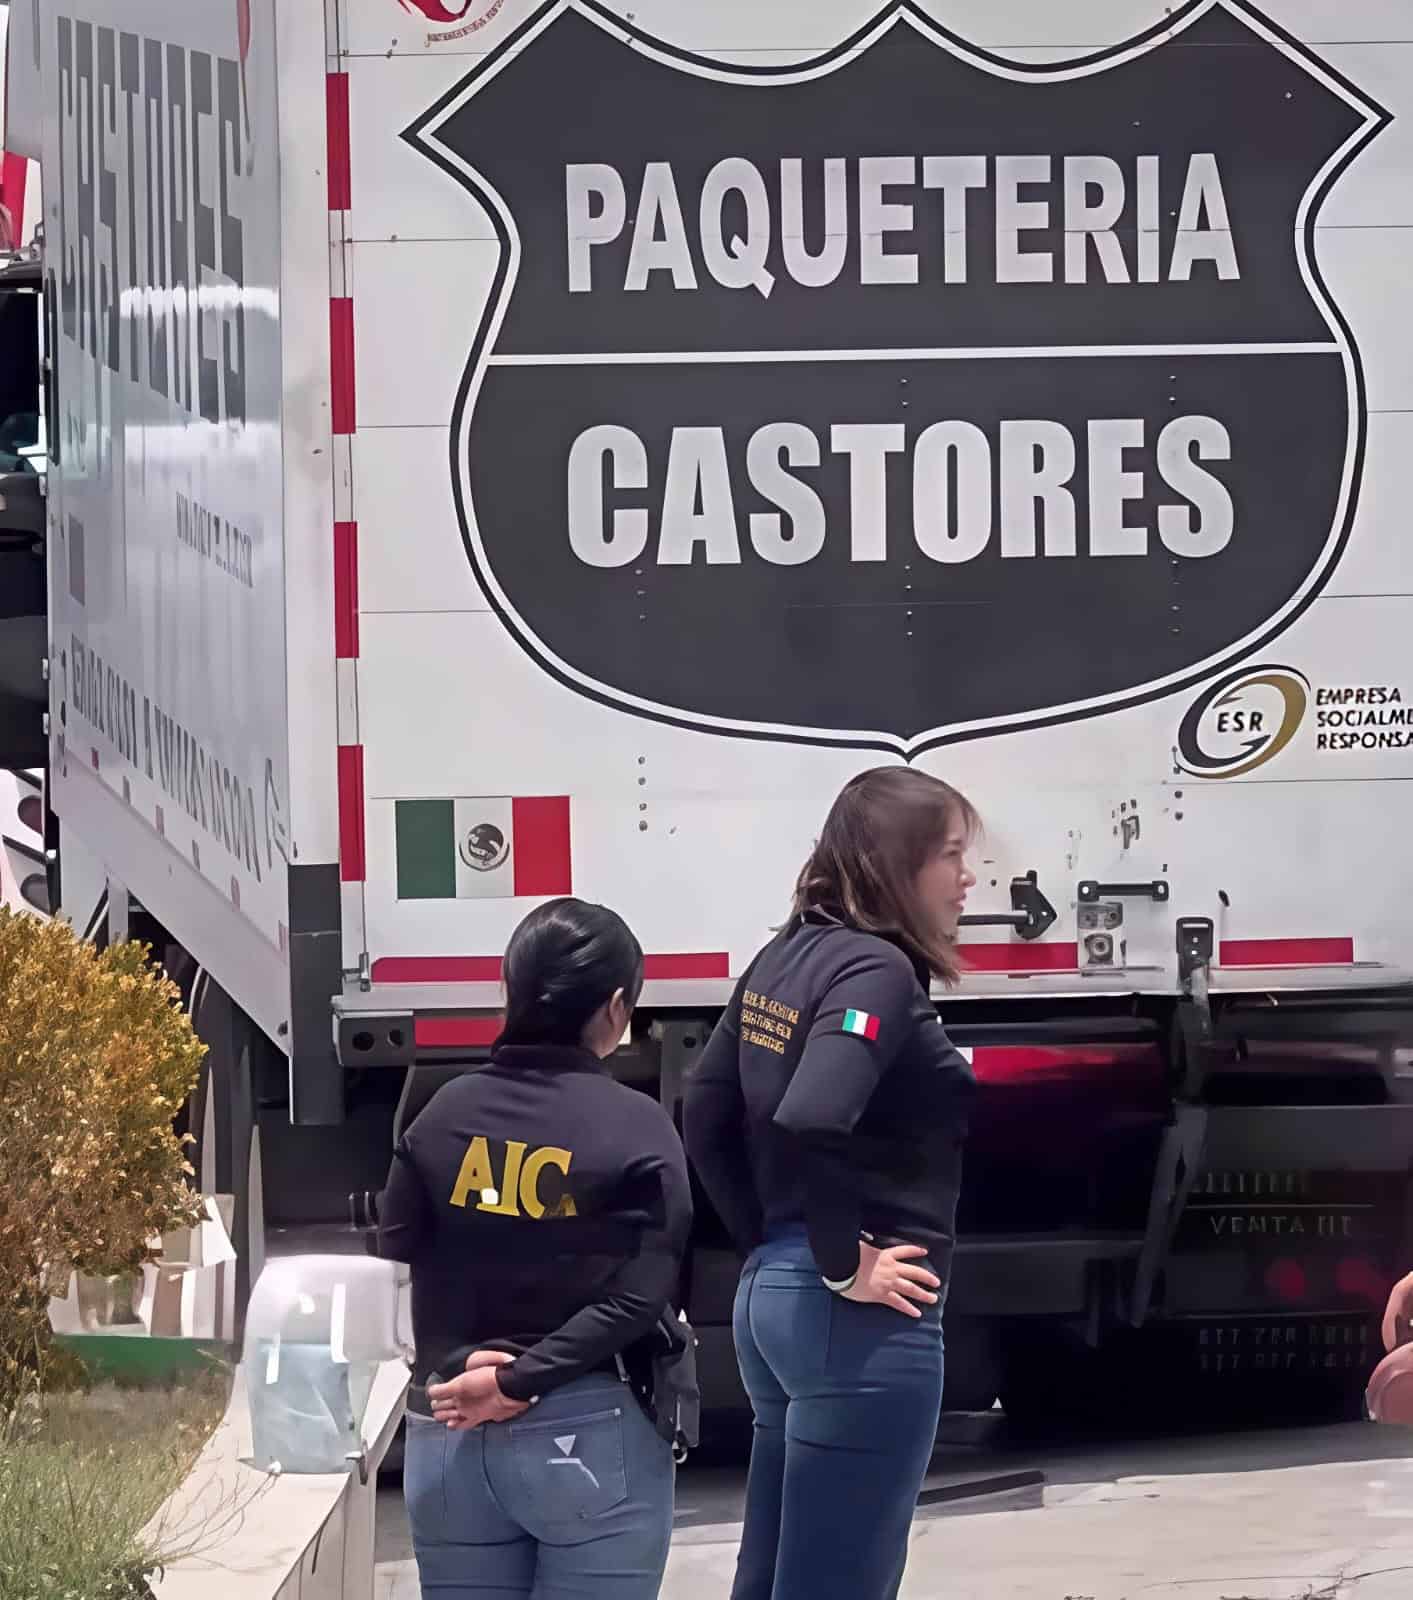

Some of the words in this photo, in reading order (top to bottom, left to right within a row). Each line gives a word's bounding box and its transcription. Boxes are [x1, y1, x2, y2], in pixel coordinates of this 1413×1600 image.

[565, 152, 1241, 300] PAQUETERIA
[567, 414, 1234, 568] CASTORES
[1217, 711, 1263, 732] ESR
[1316, 687, 1401, 706] EMPRESA
[449, 1136, 572, 1219] AIC
